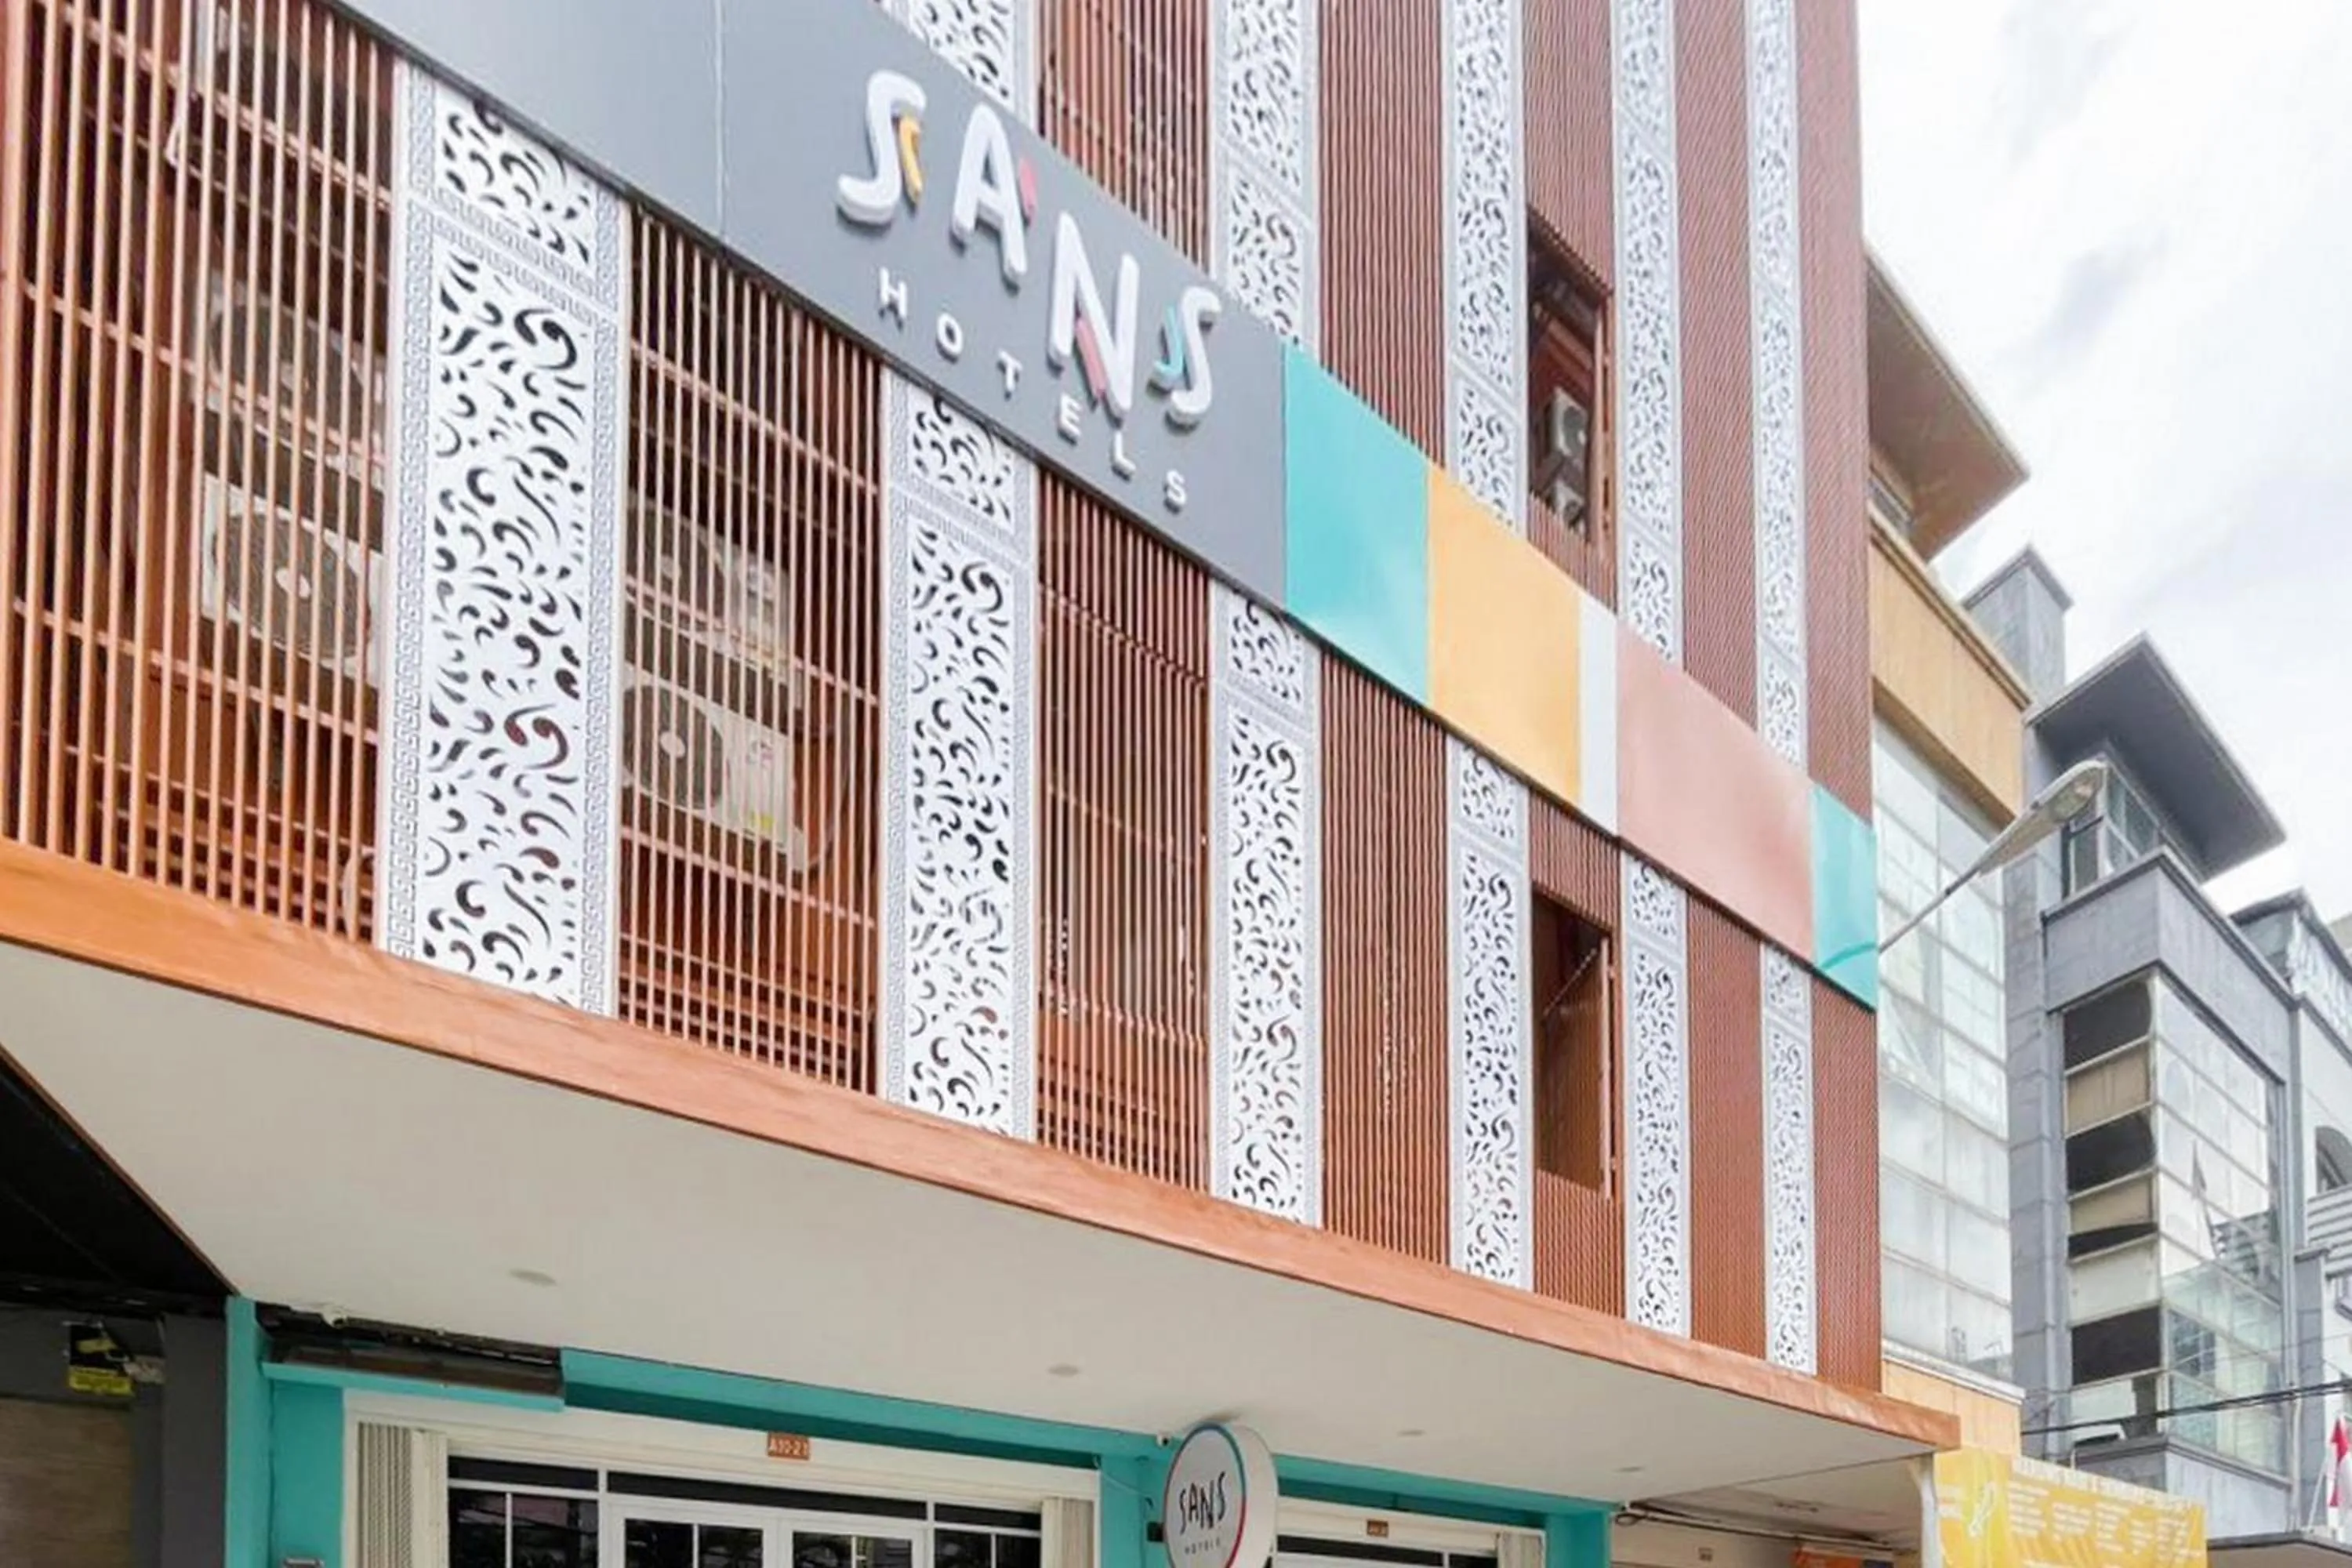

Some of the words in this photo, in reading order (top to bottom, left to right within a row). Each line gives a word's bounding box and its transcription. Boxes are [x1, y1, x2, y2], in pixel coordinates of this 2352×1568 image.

[837, 70, 1221, 424] SANS
[878, 267, 1187, 508] HOTELS
[1179, 1471, 1226, 1534] SANS
